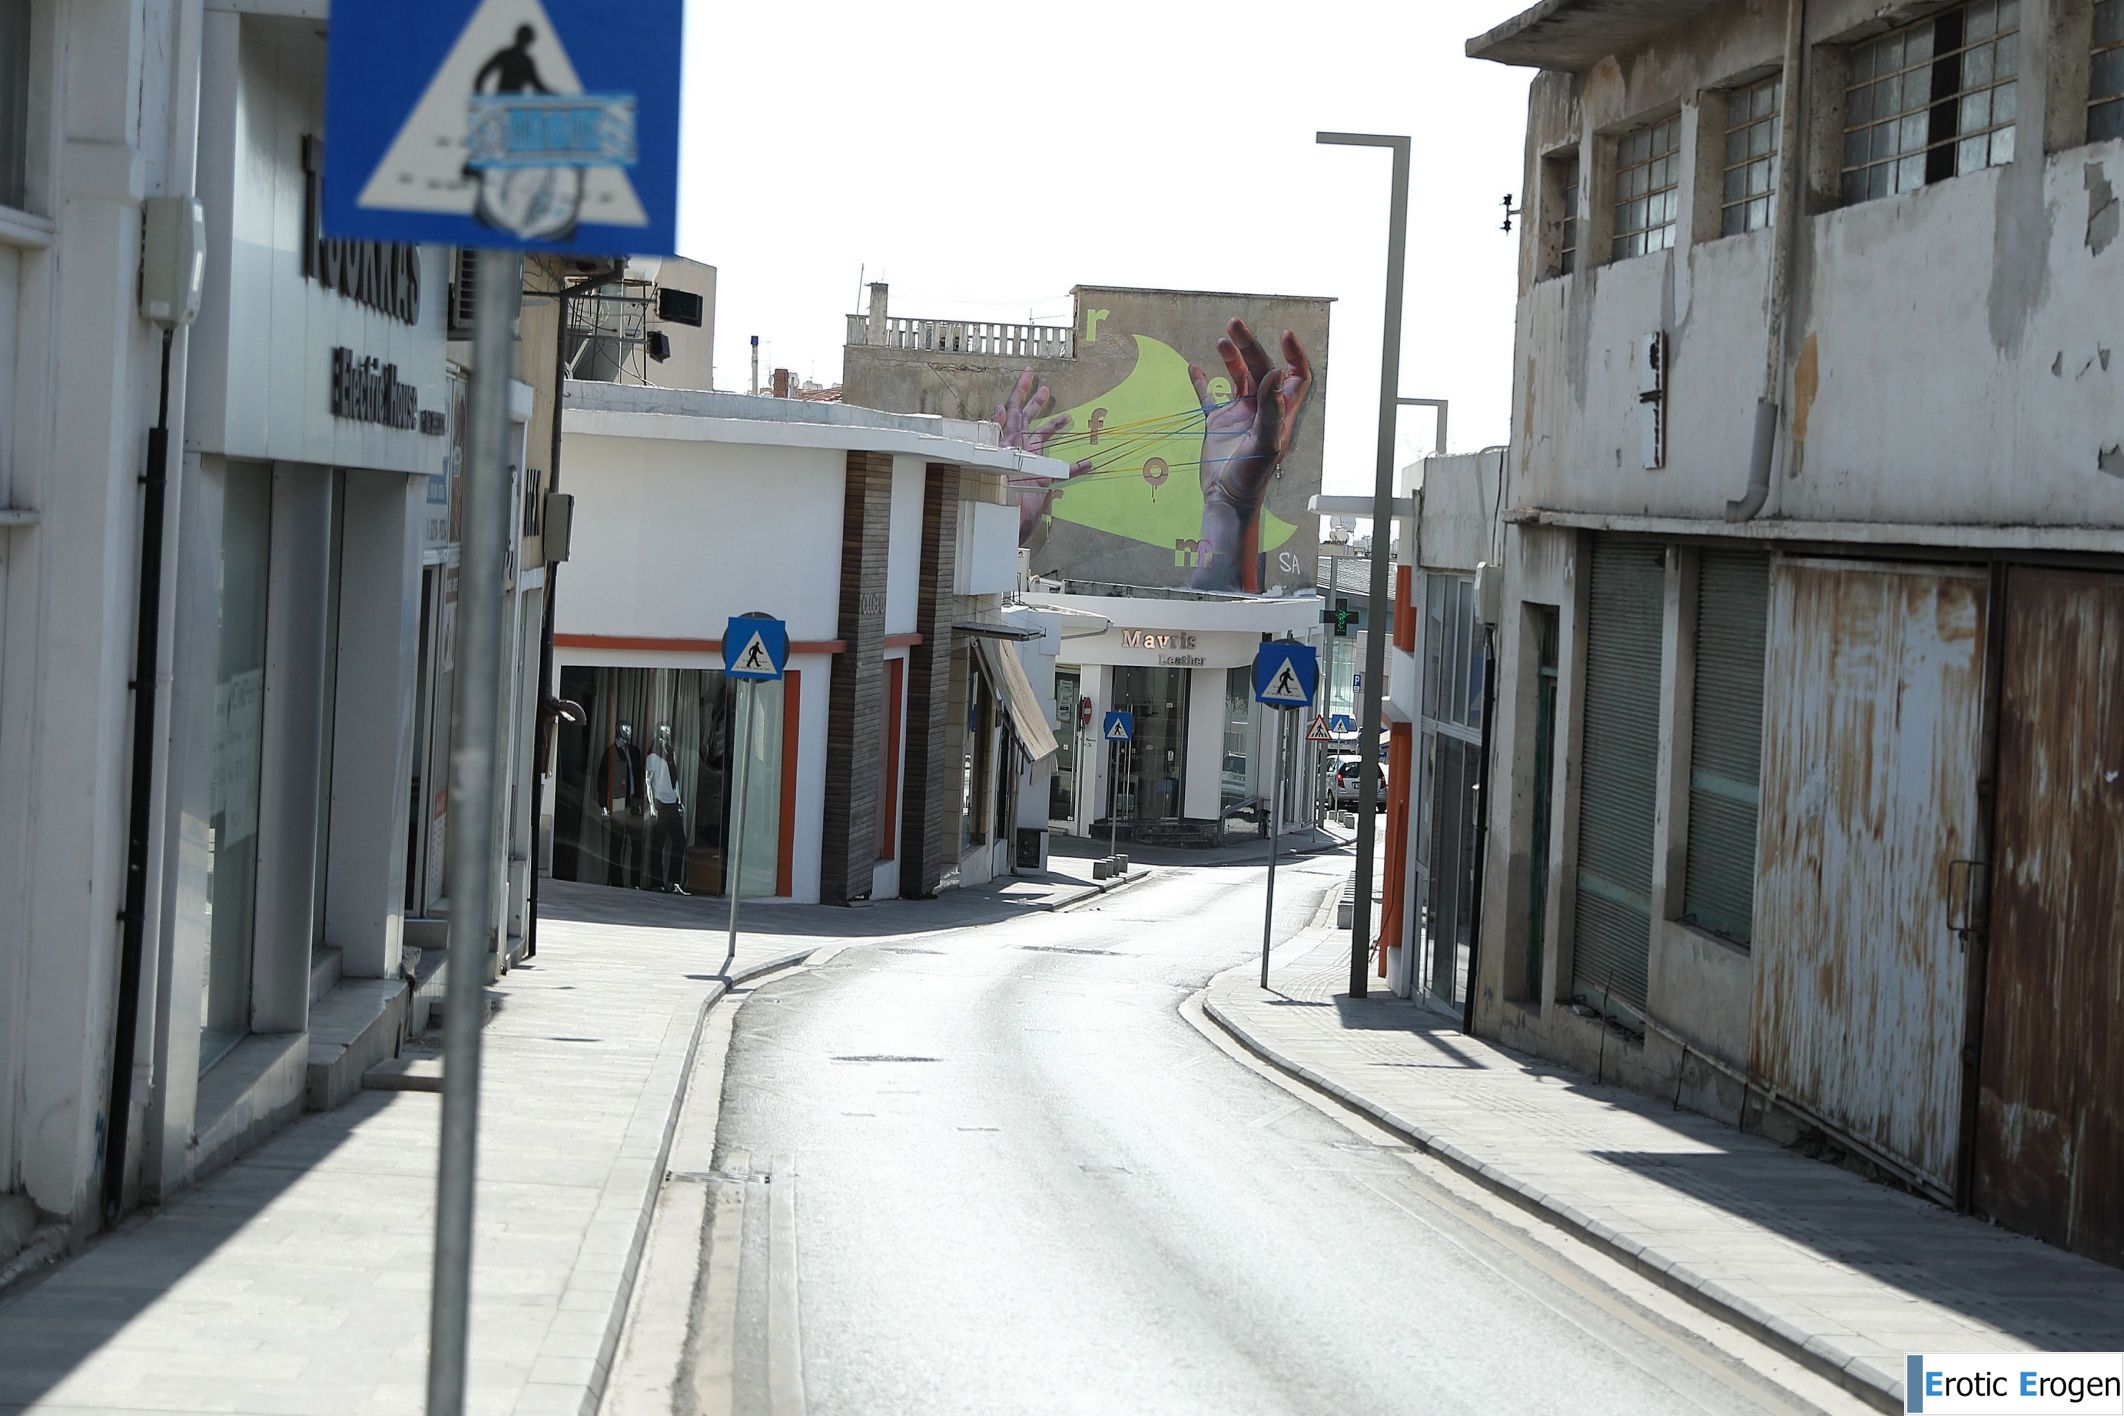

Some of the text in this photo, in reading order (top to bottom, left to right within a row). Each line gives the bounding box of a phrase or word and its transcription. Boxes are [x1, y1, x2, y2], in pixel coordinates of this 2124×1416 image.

[1086, 308, 1110, 342] r
[331, 346, 418, 431] Electric House
[1207, 376, 1232, 404] e
[1087, 407, 1108, 445] f
[1174, 537, 1213, 569] m
[1279, 552, 1301, 575] SA
[1122, 629, 1197, 650] Mavris
[1158, 653, 1206, 667] Leather
